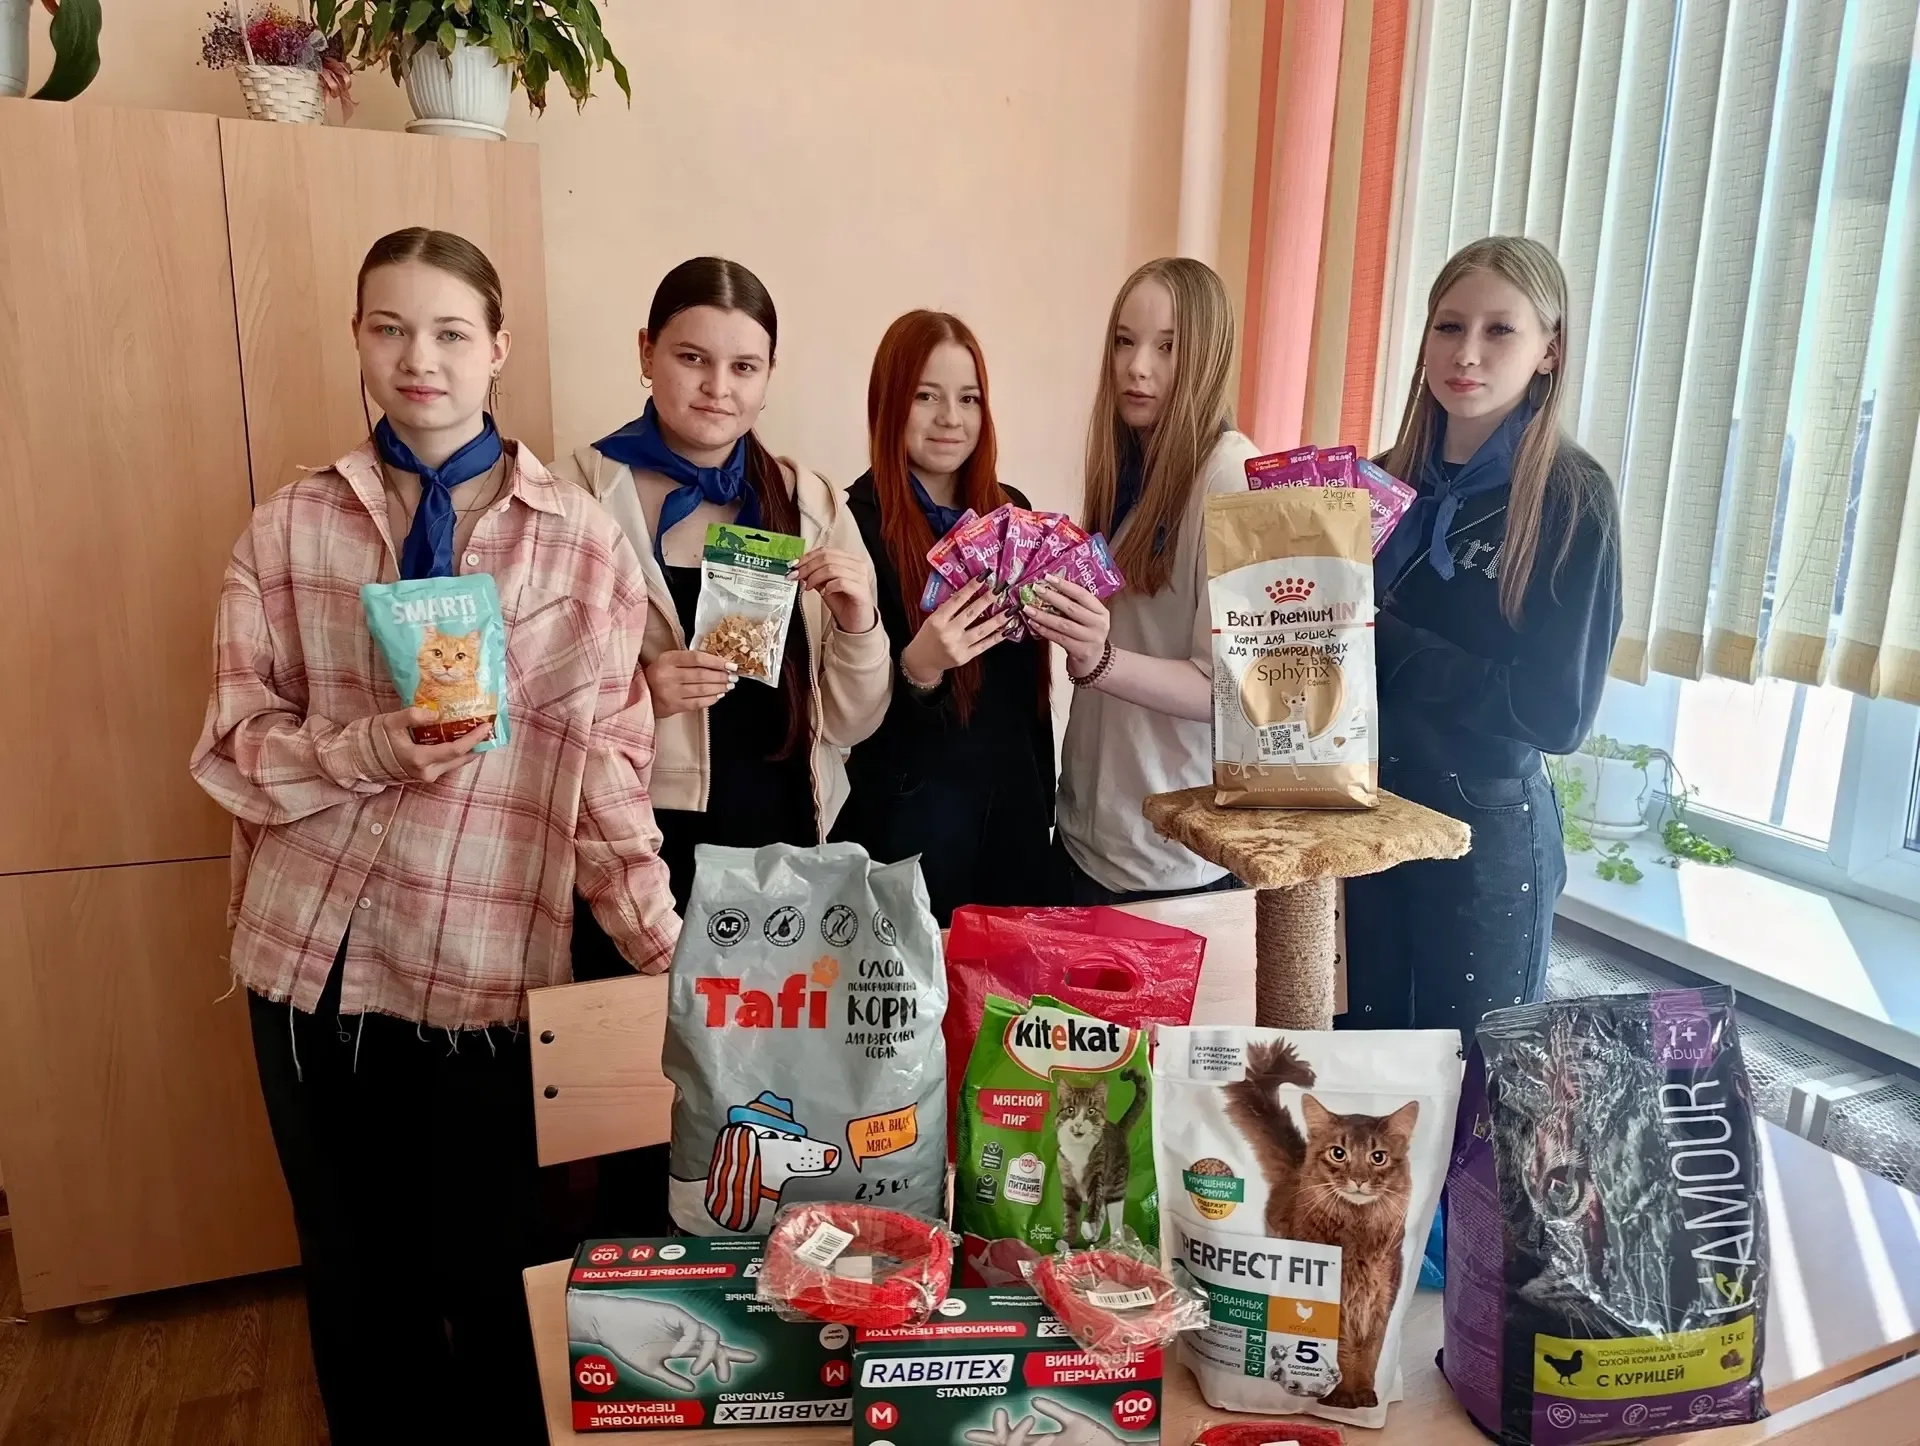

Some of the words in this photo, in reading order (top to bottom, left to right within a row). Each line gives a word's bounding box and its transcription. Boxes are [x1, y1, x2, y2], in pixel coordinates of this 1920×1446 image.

[1323, 490, 1329, 498] 2
[1227, 610, 1264, 626] BRIT
[1234, 634, 1258, 645] КОРМ
[1264, 634, 1285, 645] ДЛЯ
[1295, 628, 1337, 641] КОШЕК
[1228, 645, 1247, 657] ДЛЯ
[1257, 663, 1330, 685] Sphynx
[695, 966, 834, 1030] Tafi
[847, 994, 917, 1029] КОРМ
[845, 1031, 865, 1046] ДЛЯ
[1014, 1015, 1120, 1053] kitekat
[1668, 1025, 1697, 1047] 1+
[865, 1045, 898, 1060] СОБАК
[1661, 1047, 1705, 1060] ADULT
[992, 1093, 1043, 1107] МЯСНОЙ
[865, 1120, 885, 1137] ДВА
[866, 1137, 892, 1153] МЯСА
[855, 1178, 887, 1202] 2,5
[1008, 1180, 1040, 1193] ПИТАНИЕ
[1188, 1175, 1237, 1190] УЛУЧШЕННАЯ
[591, 1253, 619, 1261] 100
[632, 1248, 650, 1259] M
[1182, 1235, 1282, 1281] PERFECT
[1289, 1257, 1330, 1287] FIT
[583, 1269, 647, 1279] ПЕРЧАТКИ
[650, 1266, 726, 1276] ВИНИЛОВЫЕ
[1228, 1308, 1264, 1322] КОШЕК
[866, 1326, 933, 1337] ПЕРЧАТКИ
[935, 1325, 1017, 1335] ВИНИЛОВЫЕ
[1295, 1341, 1319, 1364] 5
[1598, 1355, 1629, 1367] СУХОЙ
[1632, 1355, 1656, 1364] КОРМ
[1658, 1353, 1675, 1362] ДЛЯ
[1678, 1348, 1705, 1359] КОШЕК
[579, 1371, 615, 1386] 100
[826, 1365, 844, 1382] M
[869, 1359, 1006, 1383] RABBITEX
[1053, 1367, 1137, 1382] ПЕРЧАТКИ
[1596, 1374, 1610, 1387] С
[1615, 1364, 1685, 1386] КУРИЦЕЙ
[719, 1391, 785, 1401] STANDARD
[936, 1386, 1008, 1398] STANDARD
[597, 1403, 676, 1414] ПЕРЧАТКИ
[722, 1402, 848, 1420] RABBITEX
[1115, 1398, 1152, 1414] 100
[590, 1414, 684, 1426] ВИНИЛОВЫЕ
[871, 1407, 892, 1424] M
[1122, 1414, 1146, 1423] штук
